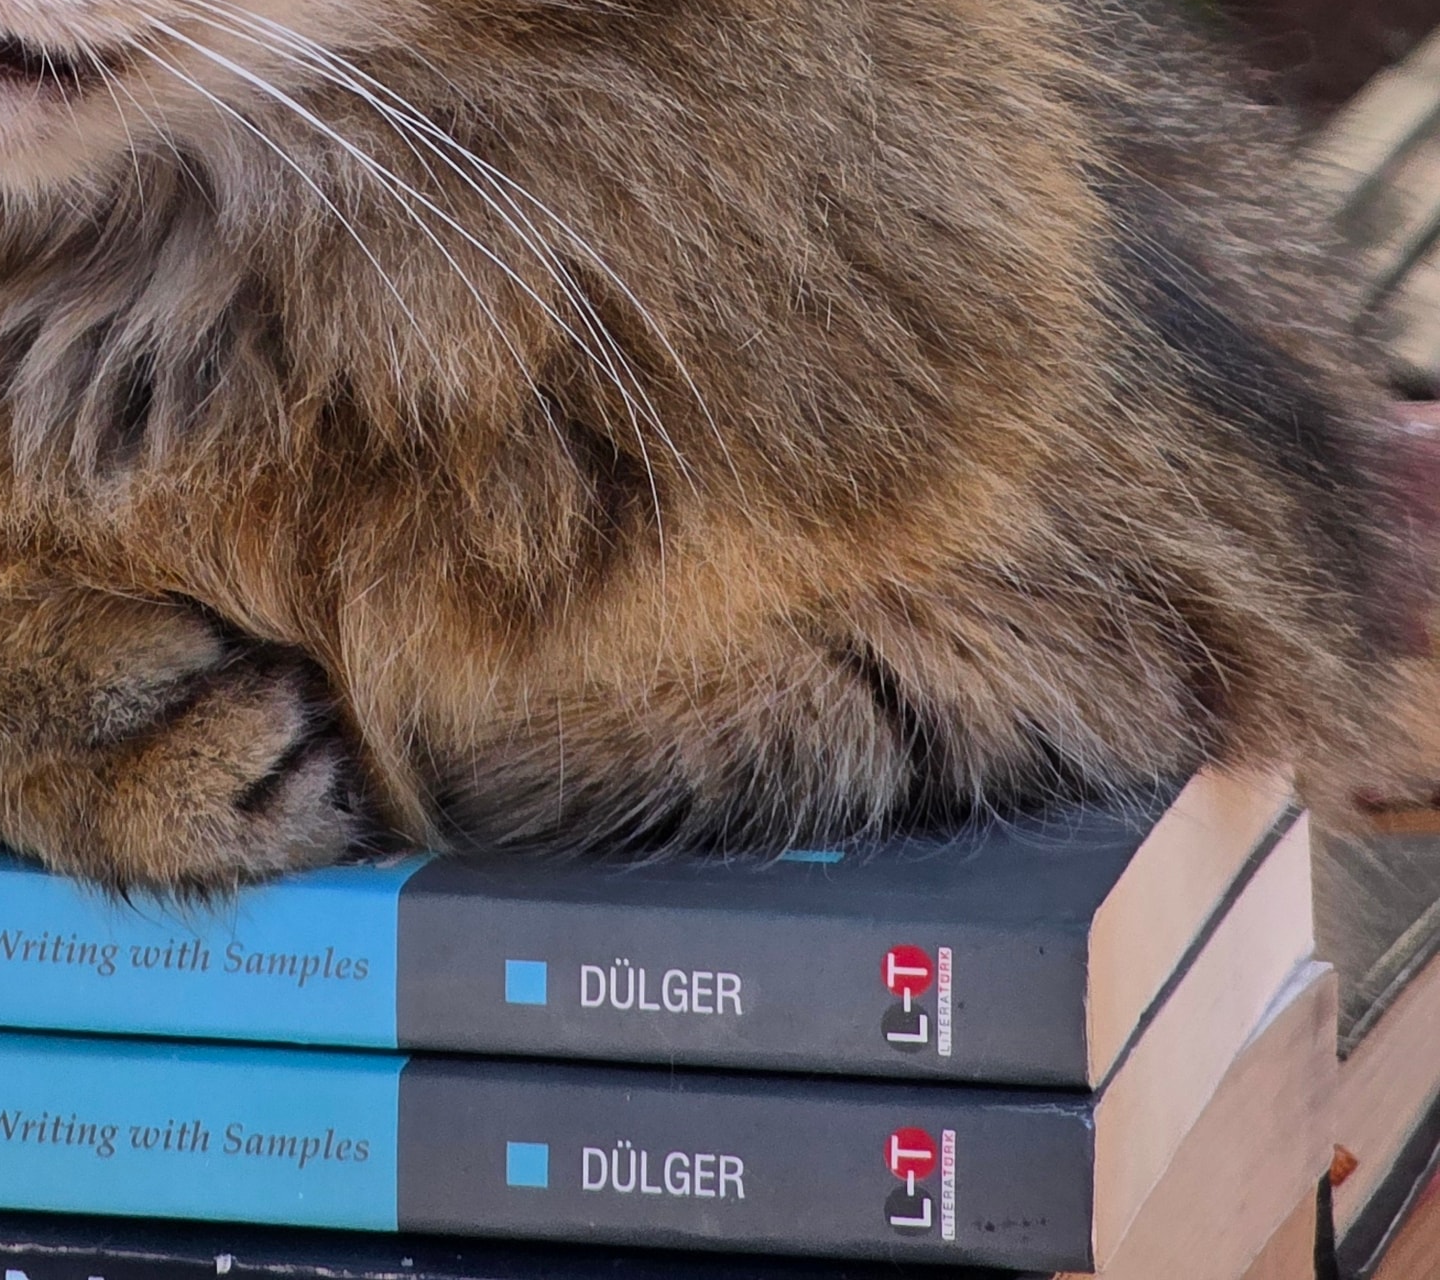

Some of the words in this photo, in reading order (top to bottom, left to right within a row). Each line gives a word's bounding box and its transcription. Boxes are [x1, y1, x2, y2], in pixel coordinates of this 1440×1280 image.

[130, 938, 211, 973] with
[224, 942, 370, 987] Samples
[580, 957, 744, 1016] DÜLGER
[129, 1120, 210, 1153] with
[223, 1123, 370, 1169] Samples
[581, 1140, 746, 1199] DÜLGER
